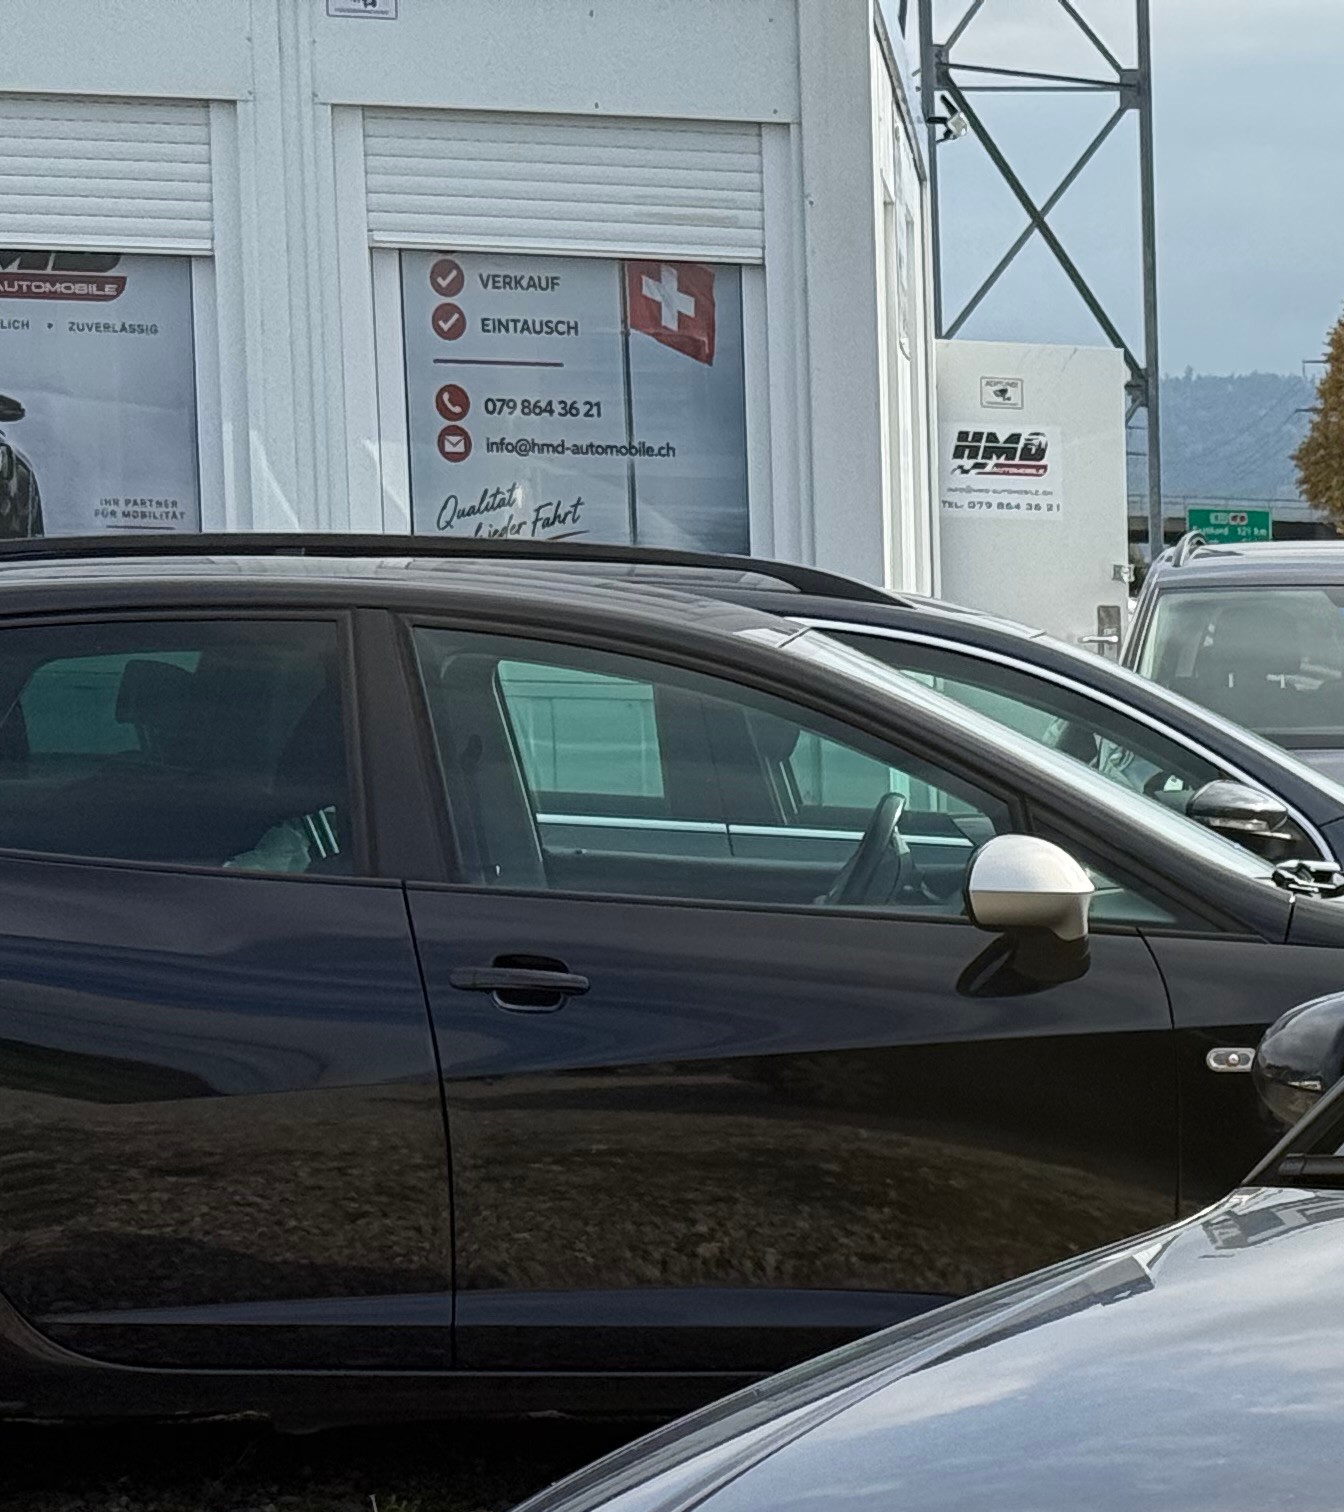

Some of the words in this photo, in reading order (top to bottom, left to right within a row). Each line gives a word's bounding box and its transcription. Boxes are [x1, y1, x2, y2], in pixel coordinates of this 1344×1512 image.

[479, 273, 561, 292] VERKAUF
[481, 317, 579, 336] EINTAUSCH
[484, 397, 517, 416] 079
[520, 399, 555, 417] 864
[558, 400, 580, 418] 36
[583, 401, 602, 418] 21
[486, 437, 676, 458] info@hmd-automobile.ch
[952, 431, 1048, 462] HMD
[100, 498, 120, 507] IHR
[125, 498, 178, 509] PARTNER
[531, 496, 585, 537] Fahrt
